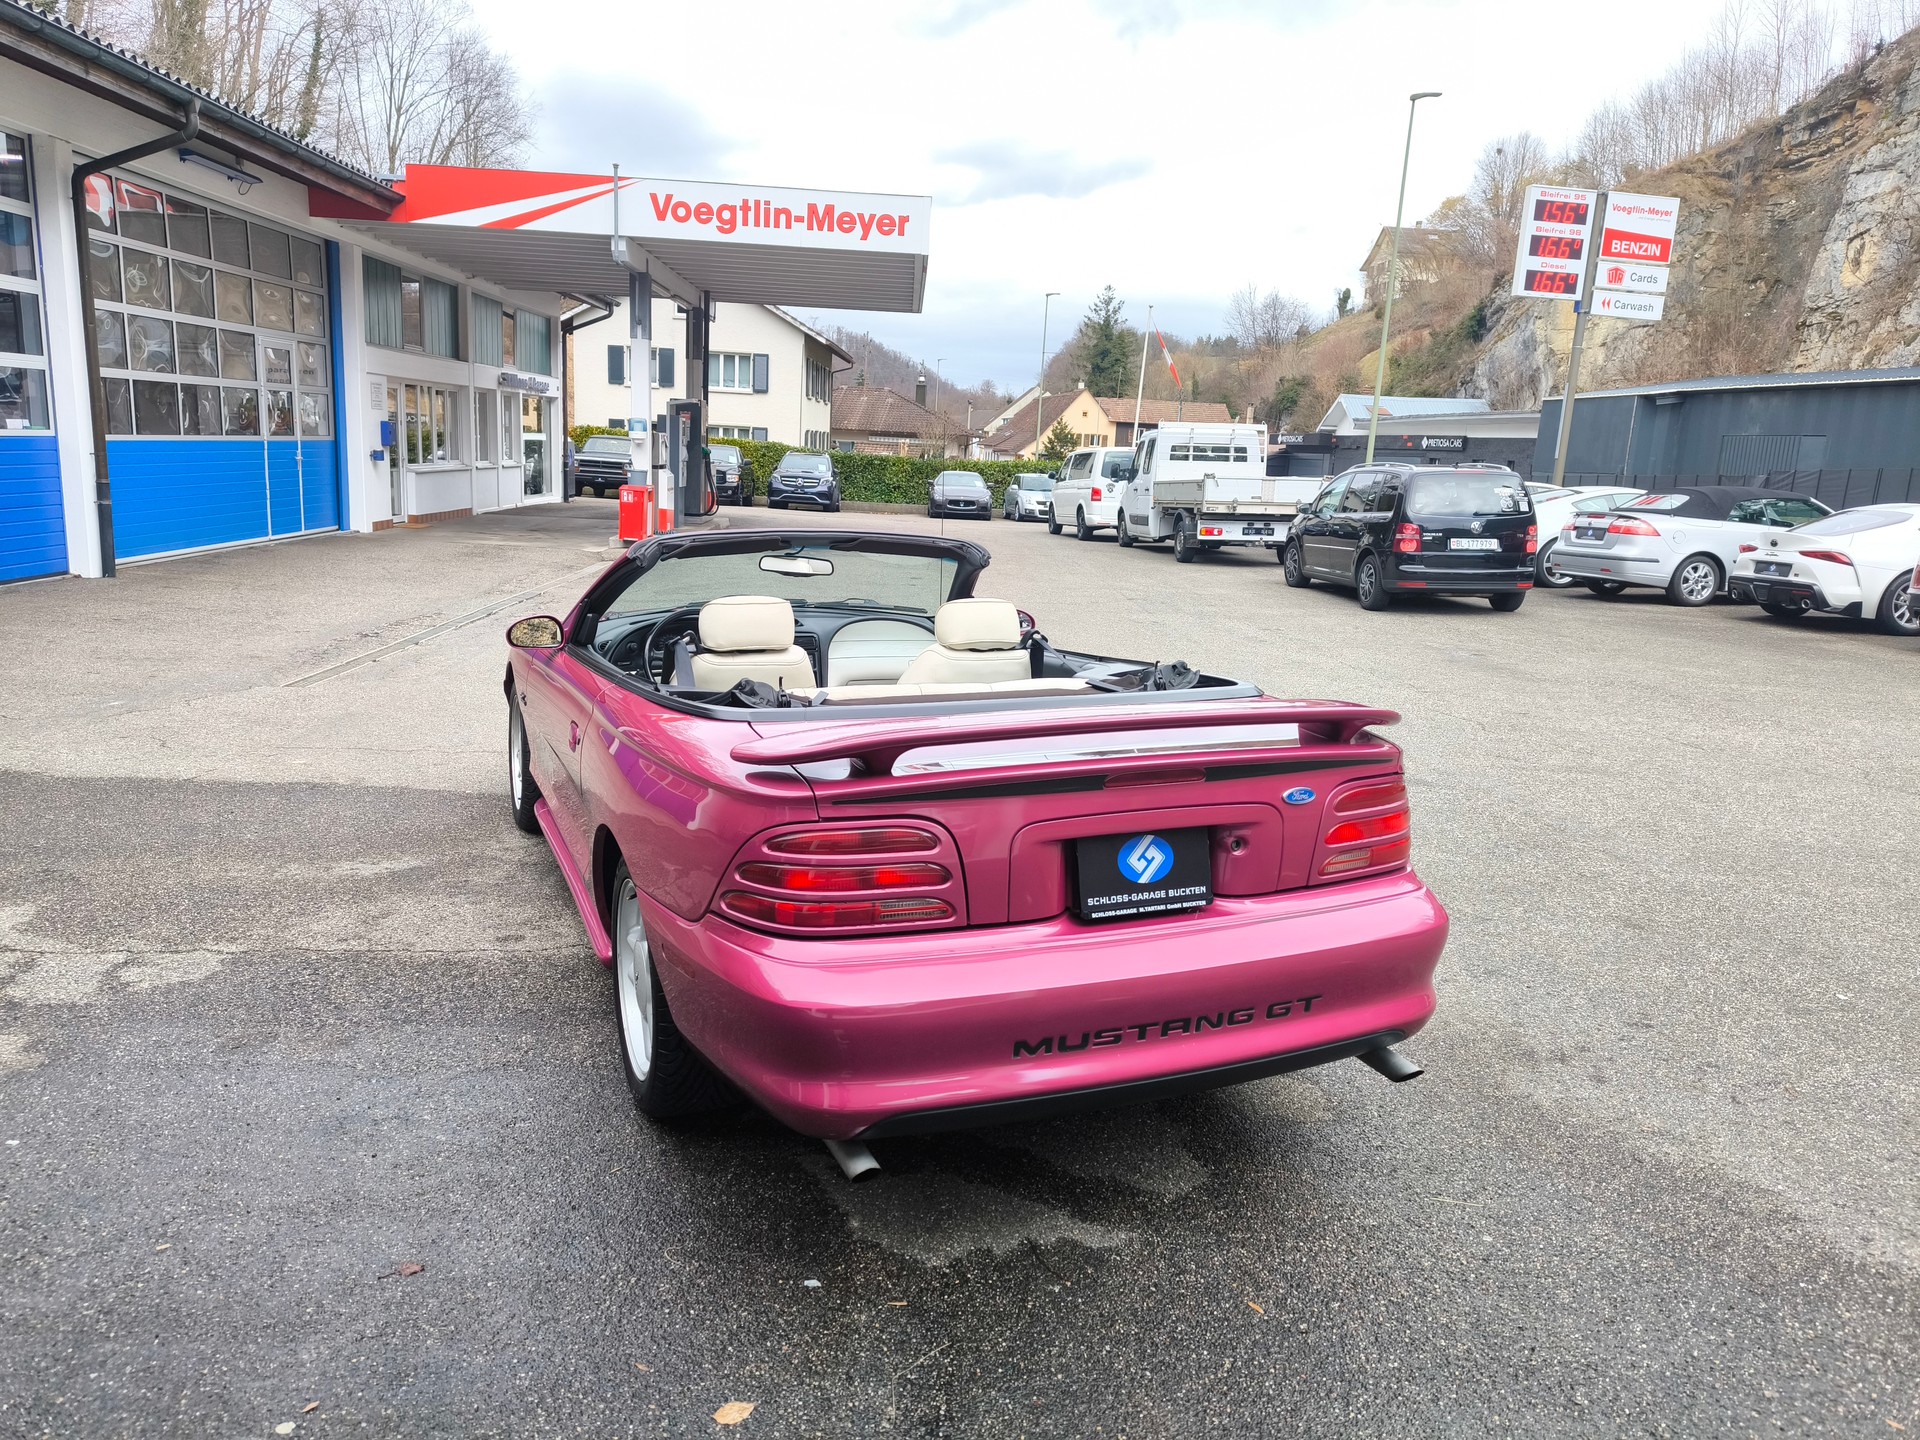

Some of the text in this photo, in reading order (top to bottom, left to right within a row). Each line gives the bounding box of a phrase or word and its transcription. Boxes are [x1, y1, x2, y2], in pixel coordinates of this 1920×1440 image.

[1540, 190, 1572, 200] Bleifrei
[649, 192, 910, 241] Voegtlin-Meyer
[1612, 203, 1673, 218] Voegtlin-Meyer
[1535, 226, 1568, 235] Bleifrei
[1611, 239, 1662, 256] BENZIN
[1540, 261, 1568, 270] Diesel
[1630, 272, 1659, 284] Cards
[1613, 300, 1655, 313] Carwash
[1428, 438, 1463, 448] PRETIOSA CARS
[1291, 790, 1310, 801] Ford
[1087, 885, 1207, 906] SCHLOSS-GARAGE BUCKTEN
[1091, 907, 1138, 919] SCHLOSS-GARAGE
[1167, 902, 1182, 910] GmbH
[1183, 900, 1207, 908] BUCKTEN
[1012, 996, 1323, 1060] MUSTANG GT
